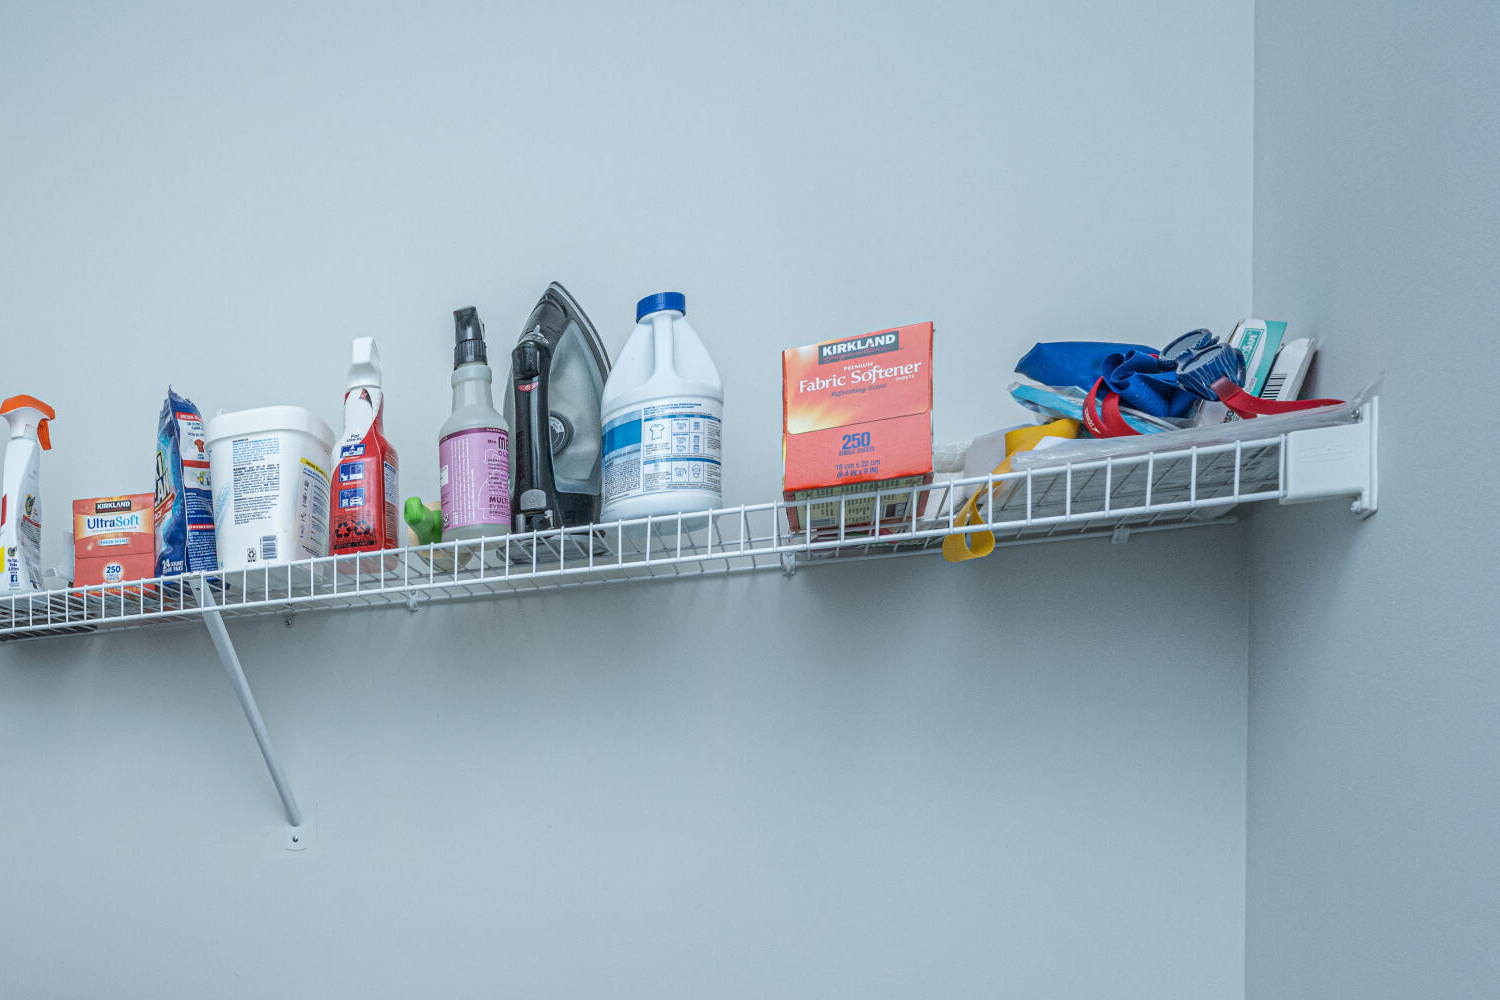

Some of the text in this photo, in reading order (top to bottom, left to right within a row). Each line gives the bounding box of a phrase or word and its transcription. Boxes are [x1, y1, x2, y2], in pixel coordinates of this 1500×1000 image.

[822, 334, 896, 357] KIRKLAND
[799, 362, 922, 393] Fabric Softener
[841, 432, 871, 450] 250
[97, 501, 130, 510] KIRKLAND
[106, 566, 121, 574] 250
